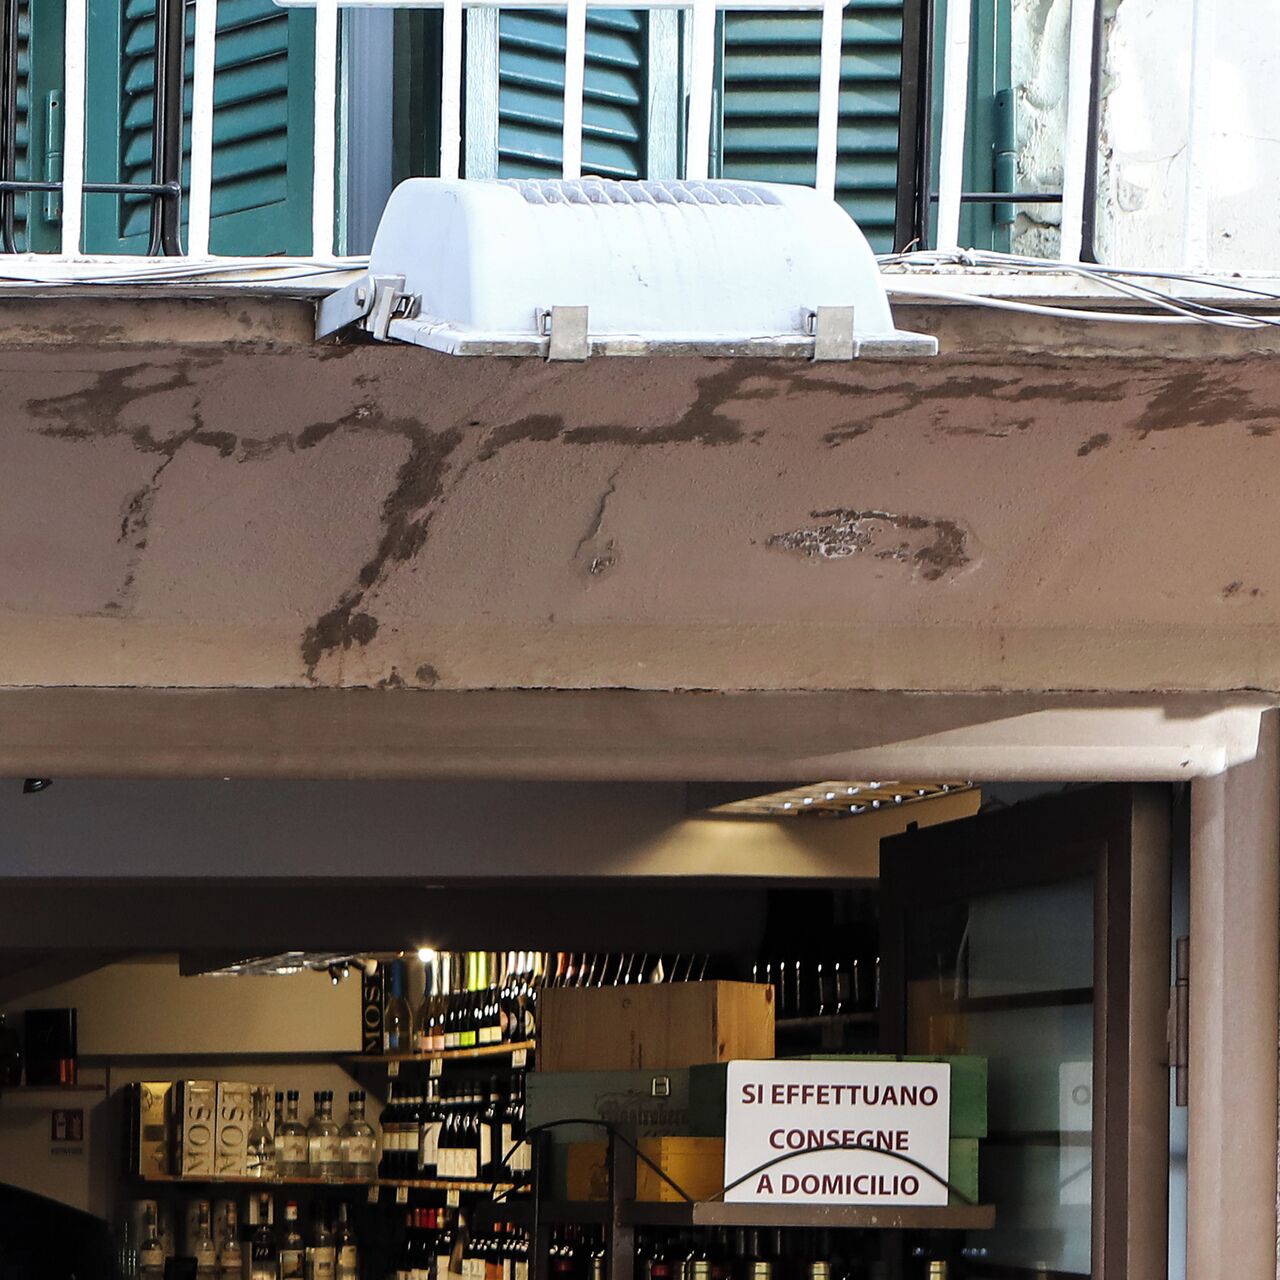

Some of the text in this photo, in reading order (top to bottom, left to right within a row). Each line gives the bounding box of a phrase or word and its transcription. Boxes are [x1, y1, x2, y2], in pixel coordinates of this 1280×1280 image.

[741, 1084, 939, 1107] SI EFFETTUANO
[768, 1129, 909, 1151] CONSEGNE
[756, 1174, 920, 1196] A DOMICILIO
